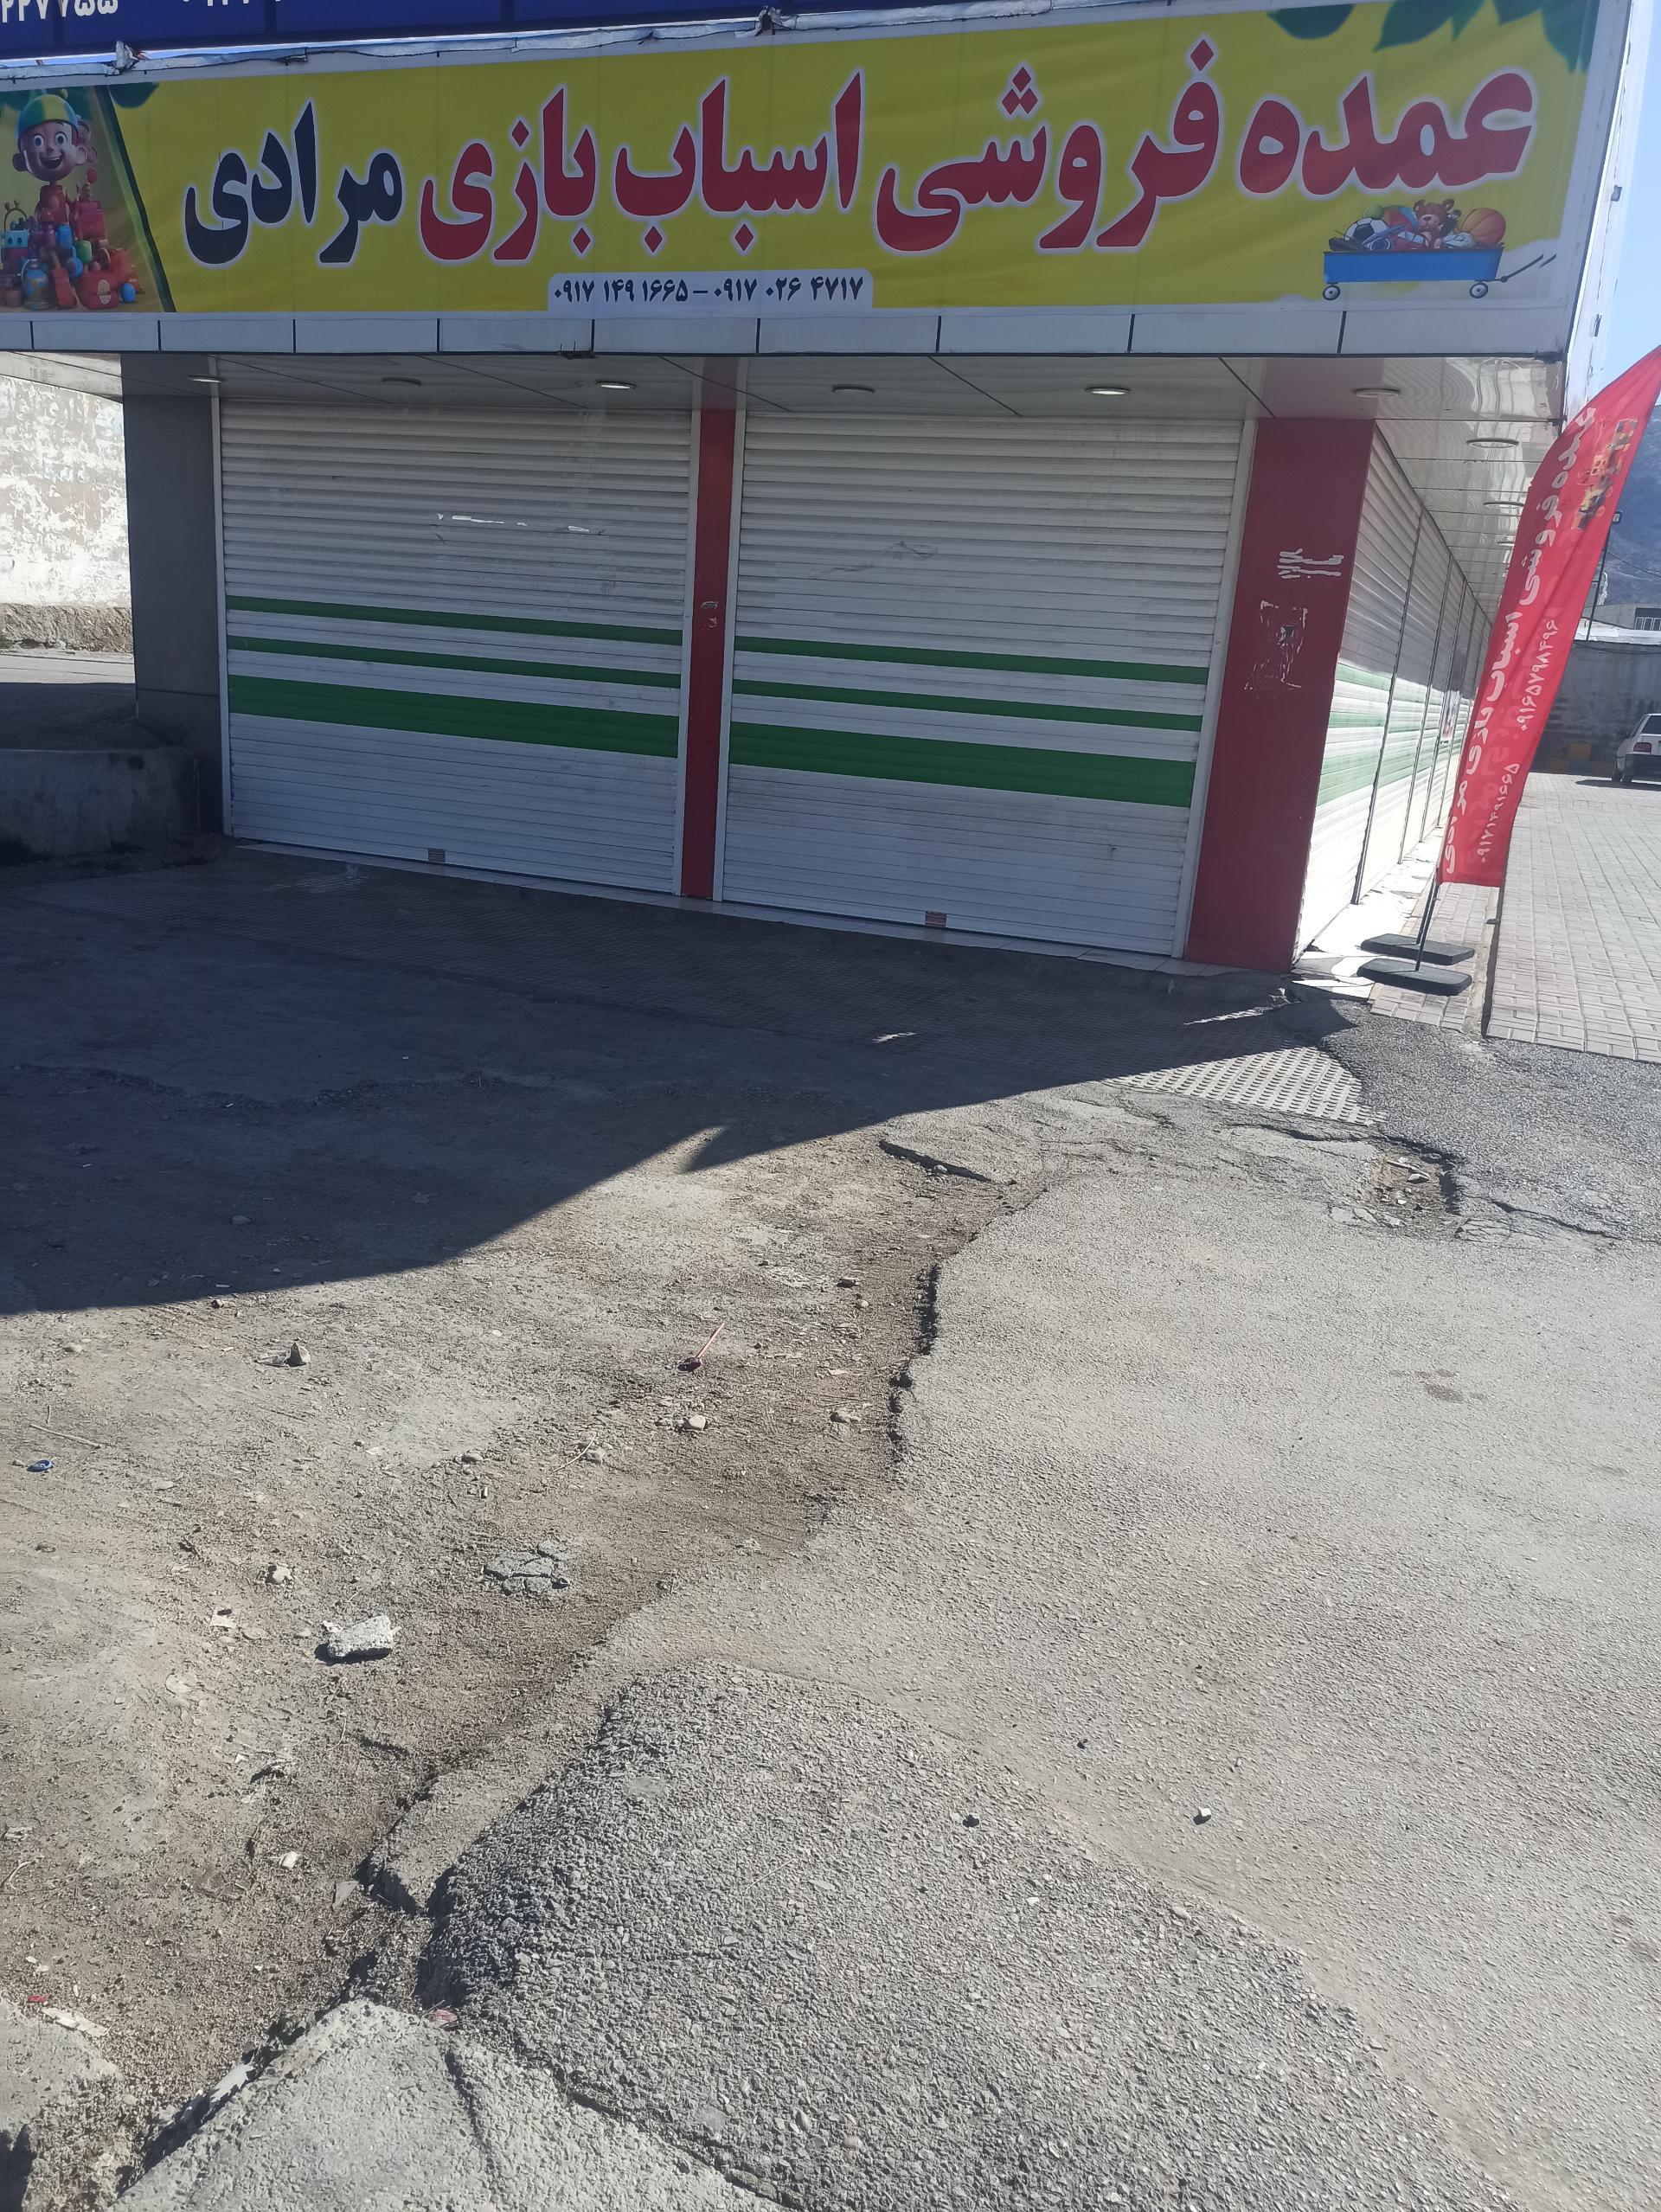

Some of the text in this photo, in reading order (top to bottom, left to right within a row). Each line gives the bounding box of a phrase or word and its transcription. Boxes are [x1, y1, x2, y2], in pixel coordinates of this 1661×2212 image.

[183, 39, 1533, 265] عمده فروشی اسباب بازی مرادی
[1551, 407, 1596, 489] عمده
[1519, 494, 1562, 606] فروشی
[1486, 612, 1523, 702] اسباب
[1445, 779, 1468, 874] مرادی
